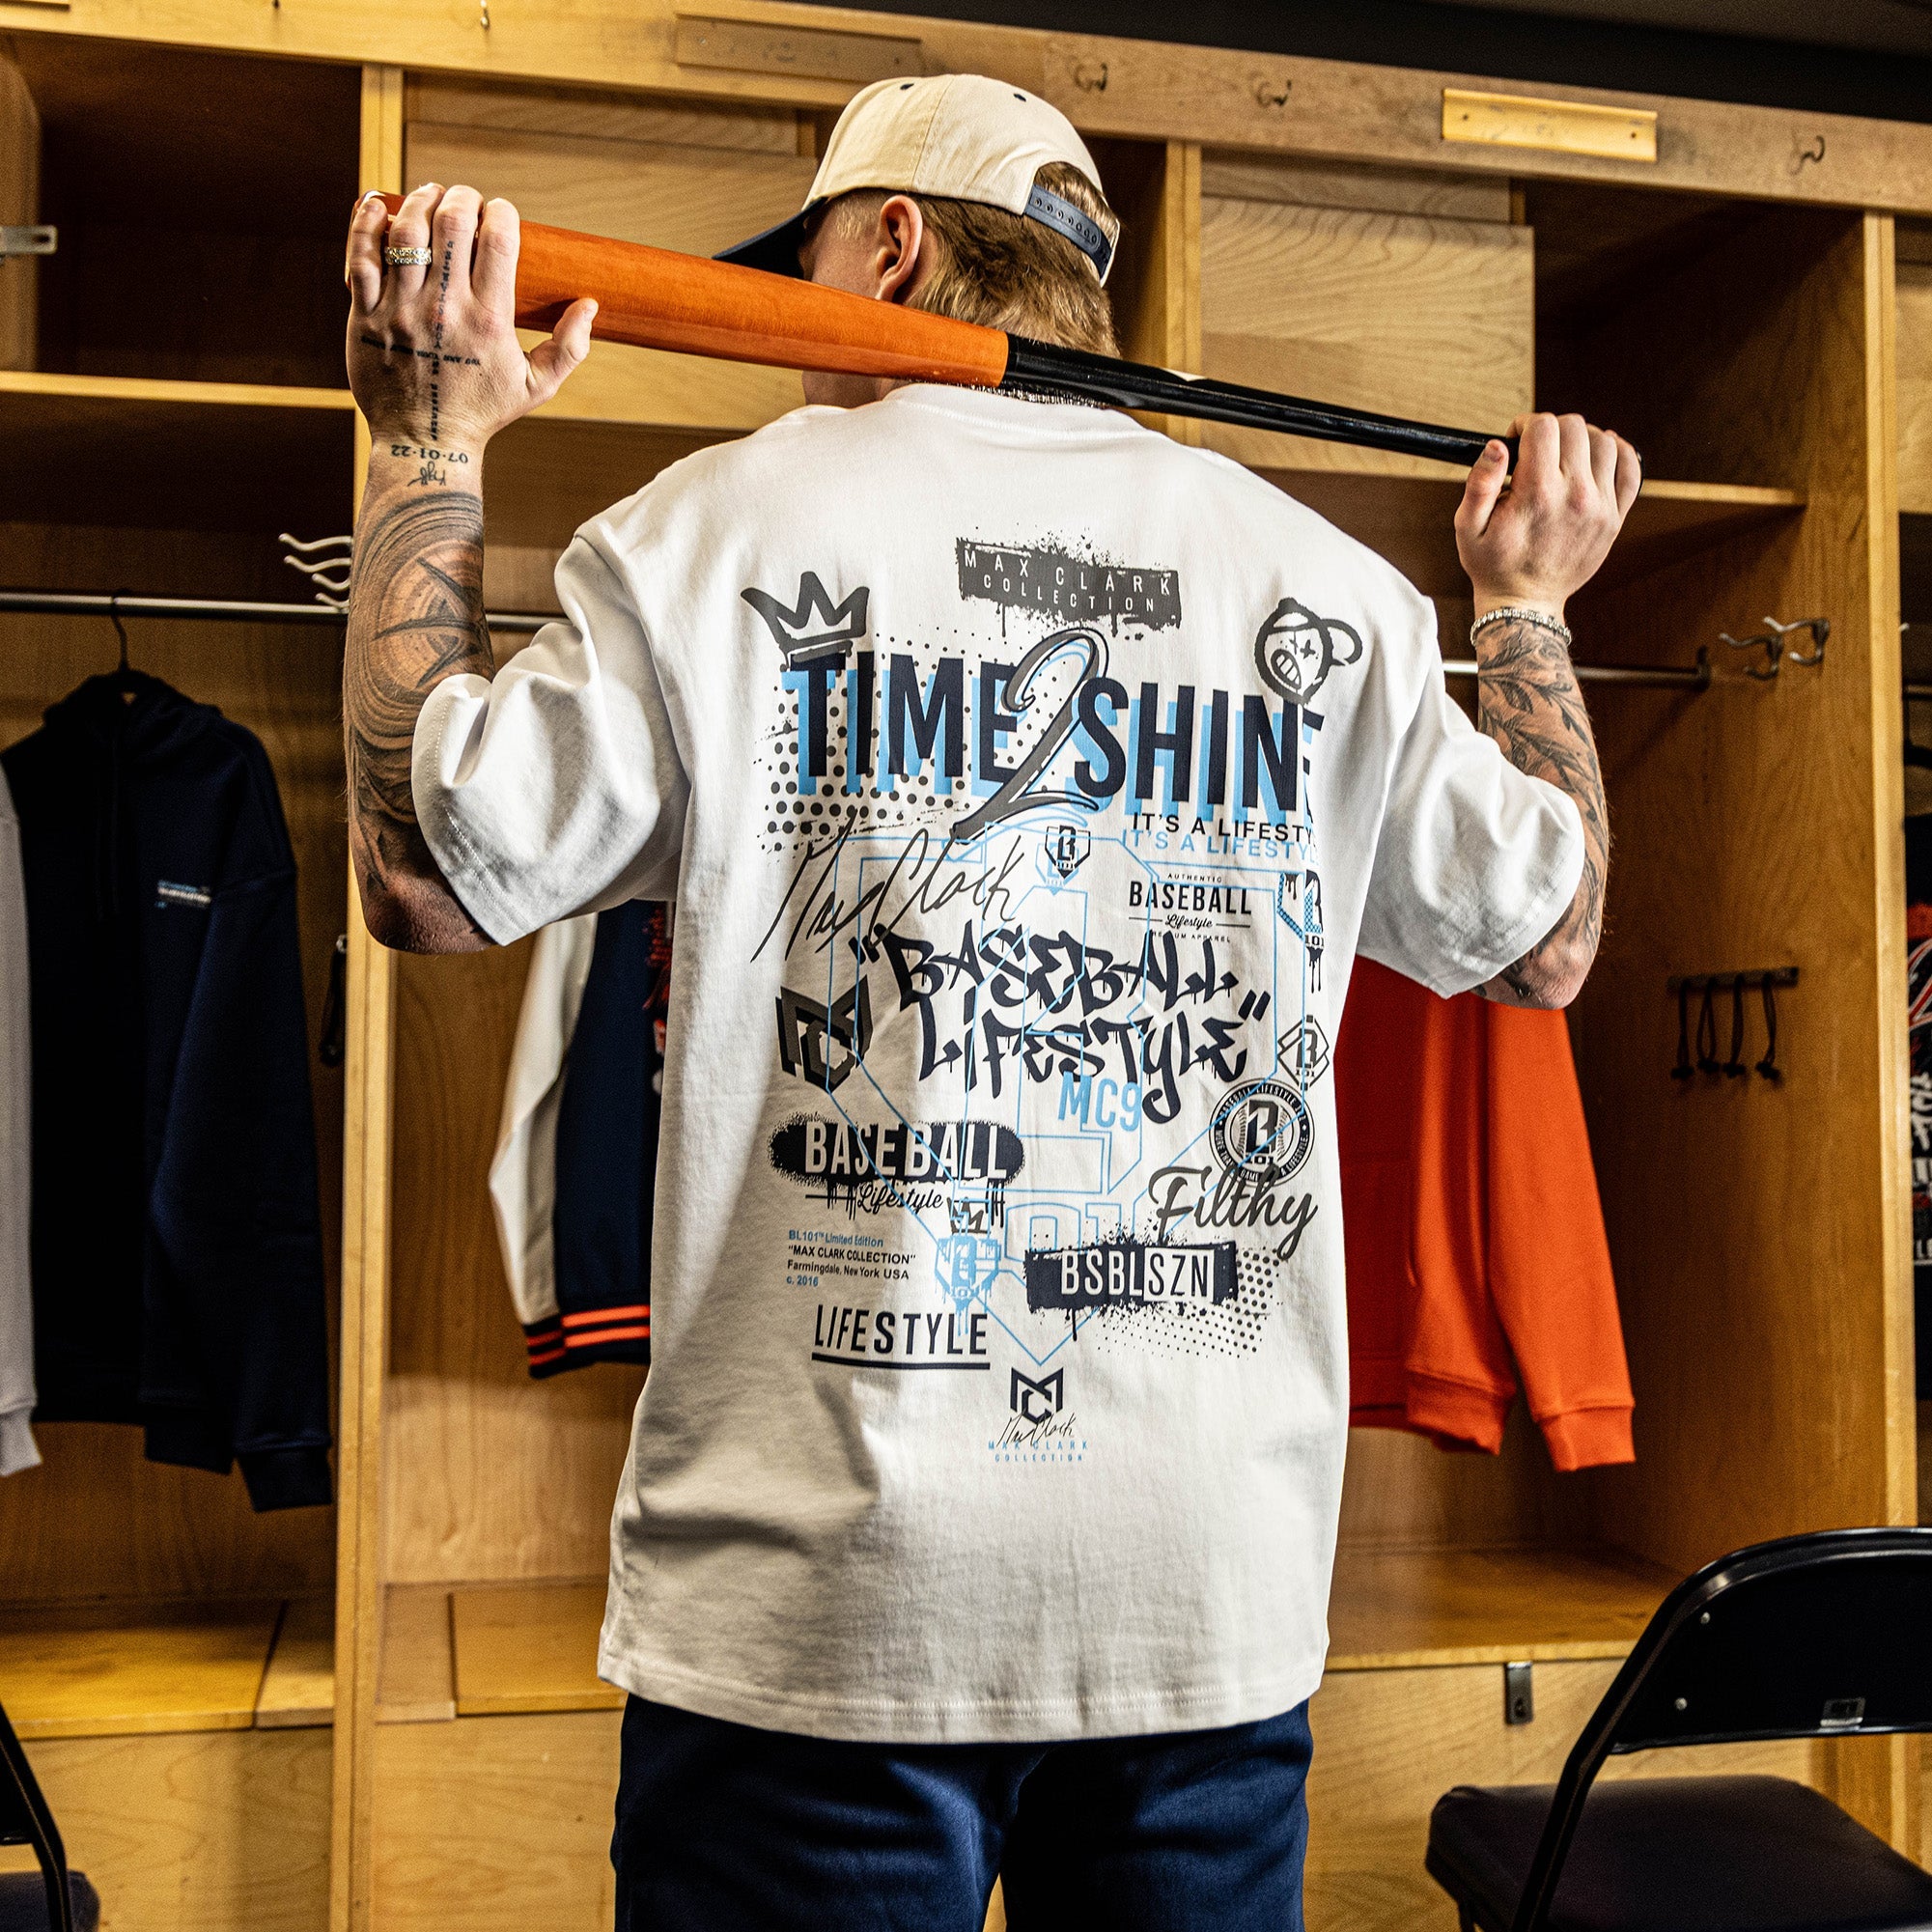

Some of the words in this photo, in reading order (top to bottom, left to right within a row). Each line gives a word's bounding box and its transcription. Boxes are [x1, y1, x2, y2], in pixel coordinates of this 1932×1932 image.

[964, 548, 1029, 578] MAX
[1055, 566, 1171, 596] CLARK
[982, 574, 1155, 613] COLLECTION
[784, 651, 1018, 786] TIME
[952, 628, 1109, 842] 2
[1132, 811, 1180, 833] IT'S
[1190, 817, 1206, 836] A
[1167, 873, 1223, 883] AUTHENTIC
[1129, 880, 1252, 915] BASEBALL
[1164, 913, 1214, 930] Lifestyle
[1057, 1070, 1142, 1133] MC9
[804, 1120, 1008, 1181] BASEBALL
[855, 1183, 945, 1214] Lifestyle
[1148, 1162, 1319, 1261] Filthy
[817, 1246, 846, 1261] CLARK
[825, 1232, 854, 1246] Limited
[854, 1235, 884, 1247] Edition
[796, 1274, 820, 1287] 2016
[843, 1264, 858, 1275] New
[859, 1266, 881, 1278] York
[882, 1268, 910, 1280] USA
[814, 1303, 989, 1356] LIFESTYLE
[994, 1453, 1082, 1462] COLLECTION
[1032, 1440, 1088, 1450] CLARK
